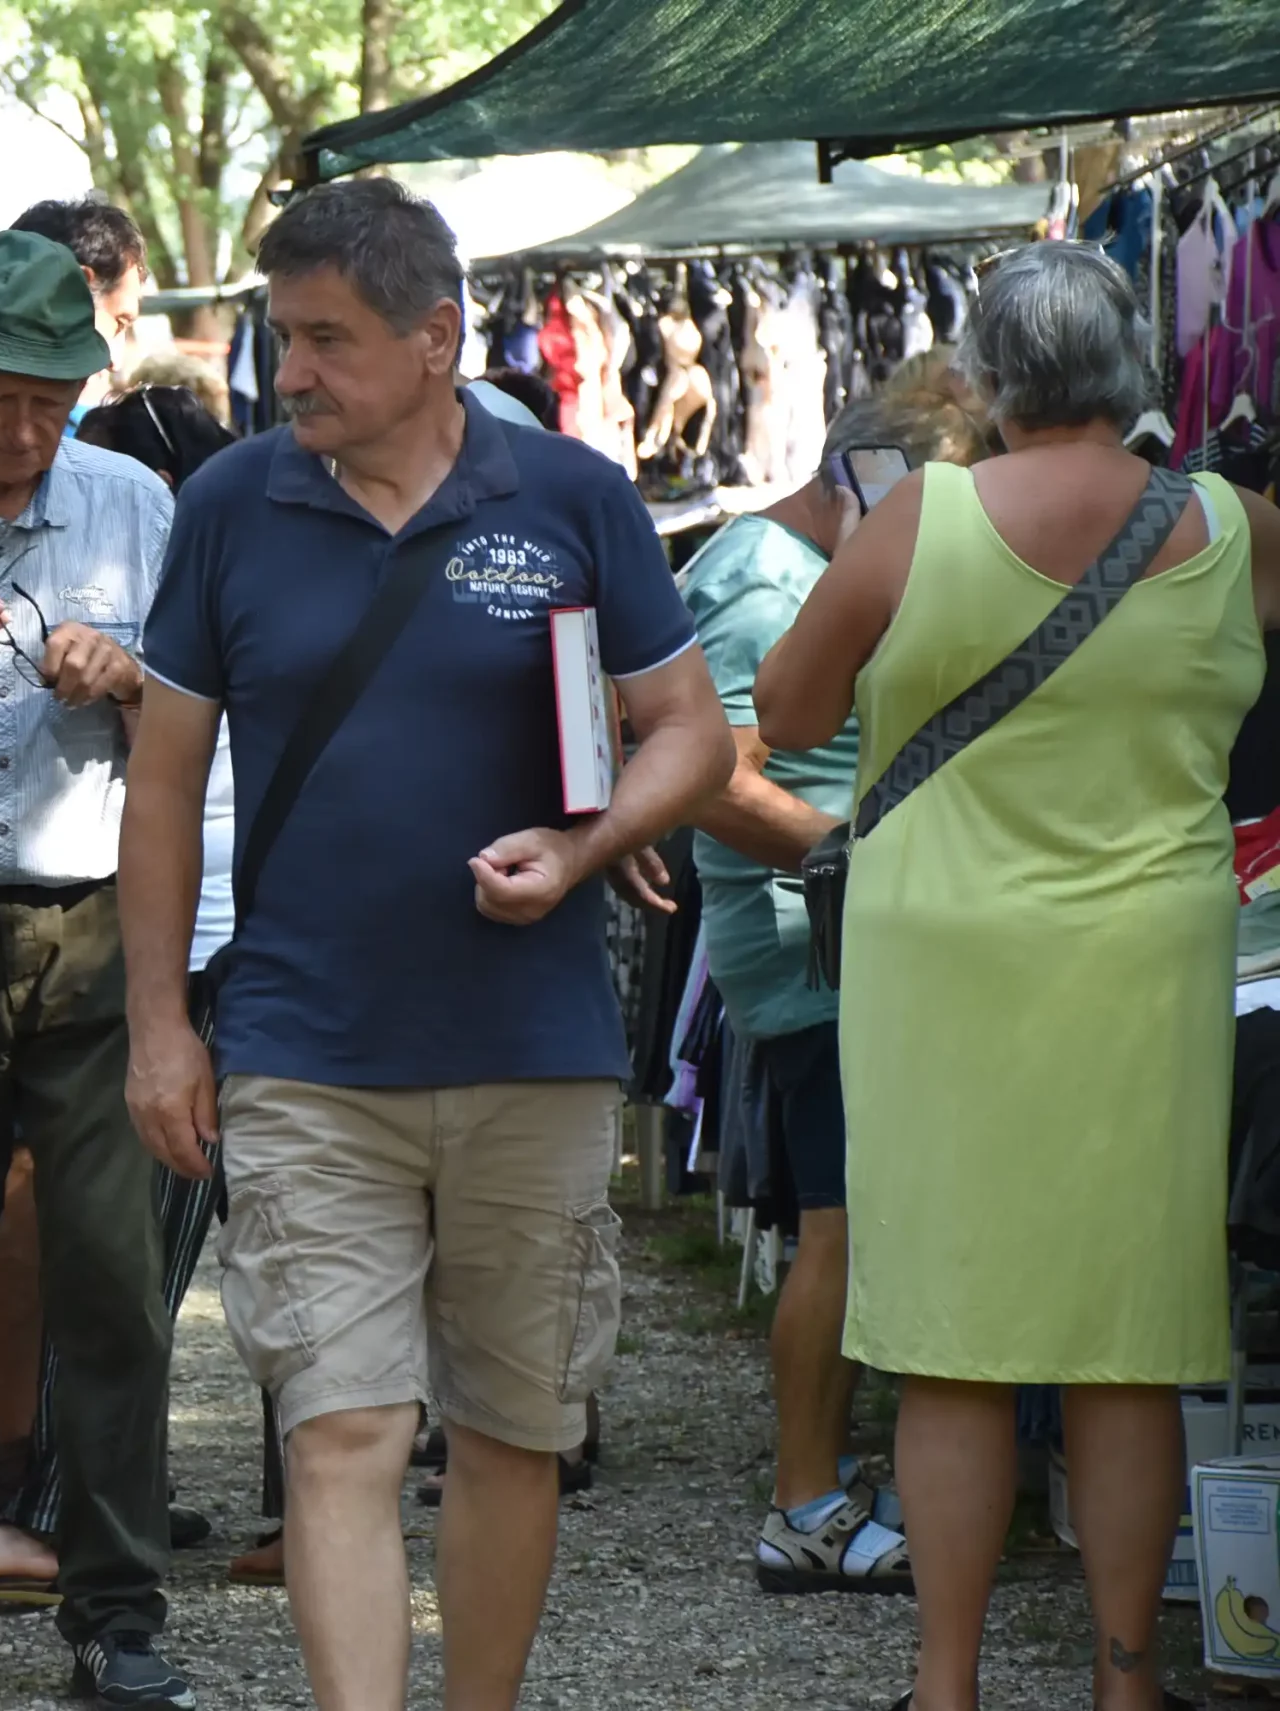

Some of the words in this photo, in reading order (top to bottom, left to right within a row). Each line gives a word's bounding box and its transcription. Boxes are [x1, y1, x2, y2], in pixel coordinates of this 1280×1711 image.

[461, 536, 488, 556] INTO
[493, 533, 516, 545] THE
[523, 540, 551, 562] WILD
[489, 548, 526, 566] 1983
[469, 581, 506, 595] NATURE
[510, 584, 551, 600] RESERVE
[487, 604, 535, 619] CANADA
